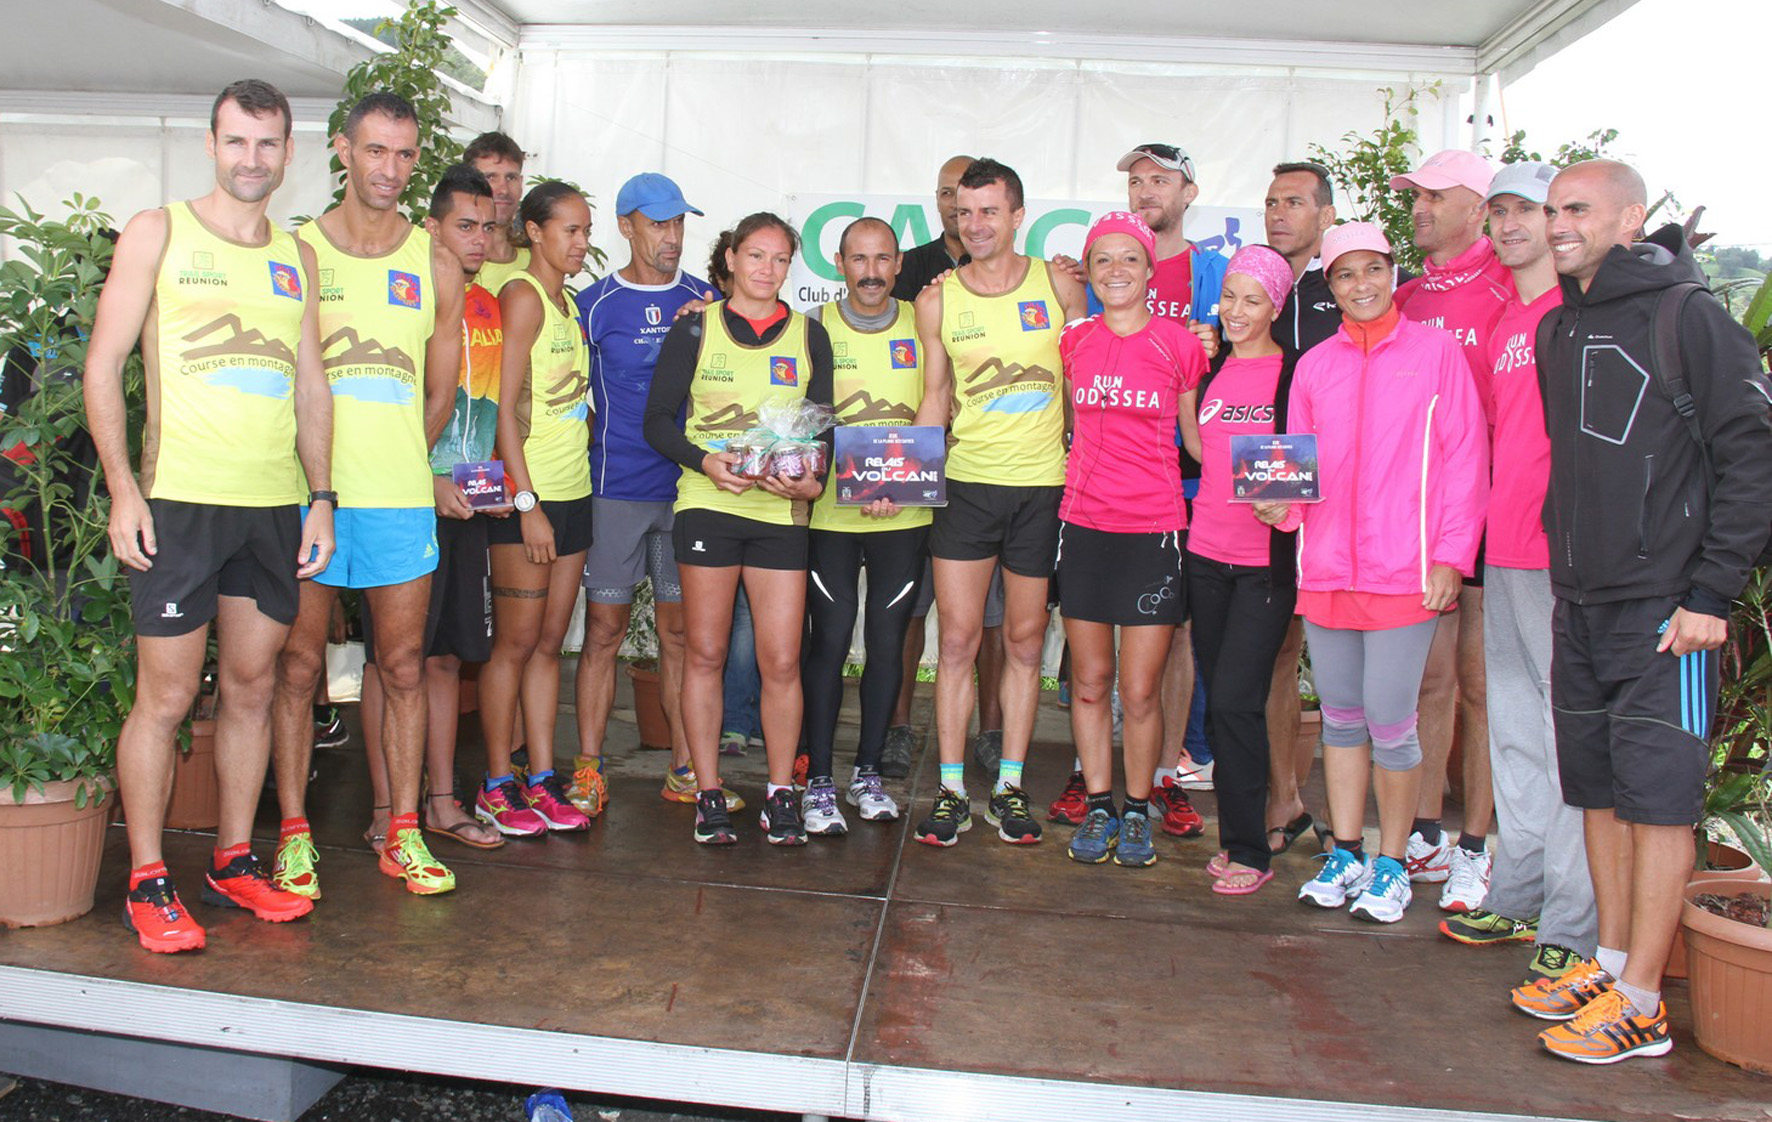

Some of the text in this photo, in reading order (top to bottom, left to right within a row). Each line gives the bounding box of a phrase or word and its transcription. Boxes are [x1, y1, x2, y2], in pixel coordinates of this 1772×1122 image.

[179, 277, 228, 286] REUNION
[319, 294, 344, 302] NION
[798, 286, 849, 303] Club d'
[1146, 300, 1191, 318] SSEA
[952, 331, 986, 343] REUNION
[180, 357, 295, 378] Course en montag
[326, 369, 343, 381] rse
[347, 366, 362, 375] en
[701, 374, 734, 382] REUNION
[1093, 374, 1123, 389] RUN
[966, 390, 995, 408] Course
[1075, 386, 1160, 409] ODYSSEA
[1221, 405, 1275, 423] asics
[865, 457, 904, 467] RELAIS
[1254, 460, 1286, 469] RELAIS
[852, 471, 931, 482] VOLCAN
